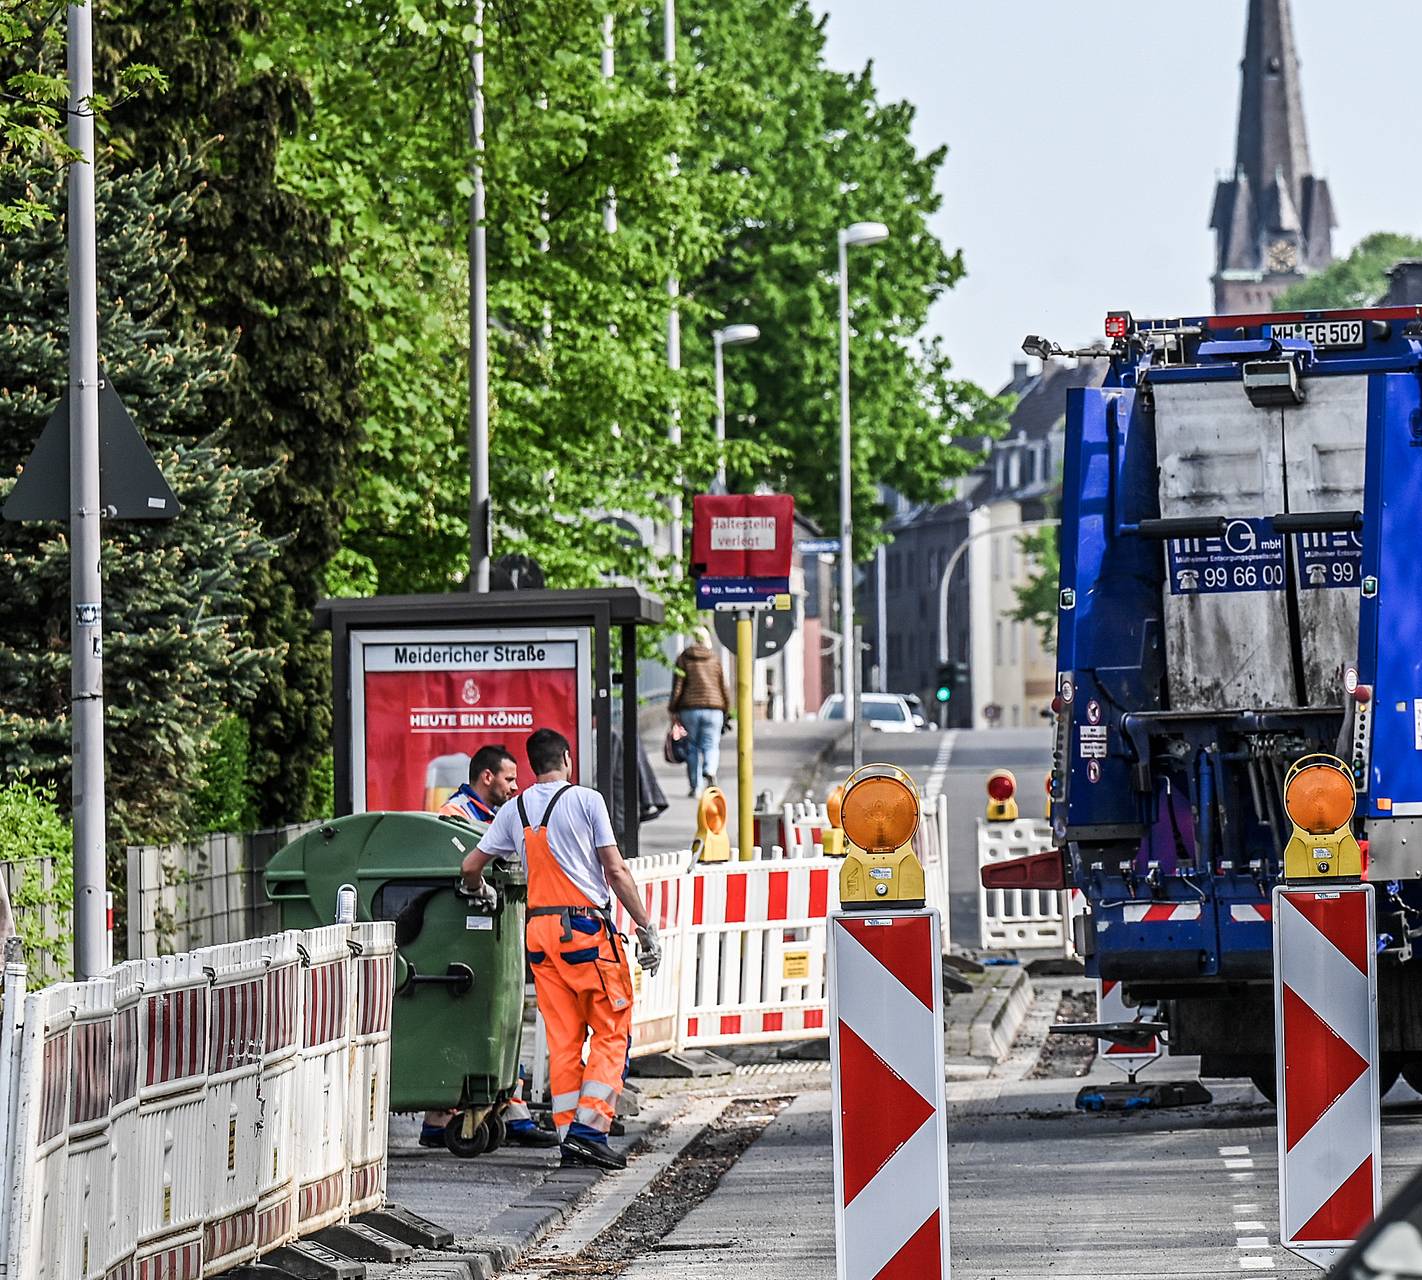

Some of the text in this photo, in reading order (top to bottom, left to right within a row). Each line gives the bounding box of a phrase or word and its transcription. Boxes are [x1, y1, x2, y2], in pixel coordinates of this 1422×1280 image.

[1272, 324, 1361, 344] MH EG 509
[711, 518, 775, 529] Haltestelle
[718, 536, 760, 548] verlegt
[1261, 539, 1282, 550] mbH
[1204, 565, 1283, 588] 99 66 00
[1332, 562, 1353, 582] 99
[395, 645, 545, 663] Meidericher Straße
[410, 711, 533, 727] HEUTE EIN KÖNIG
